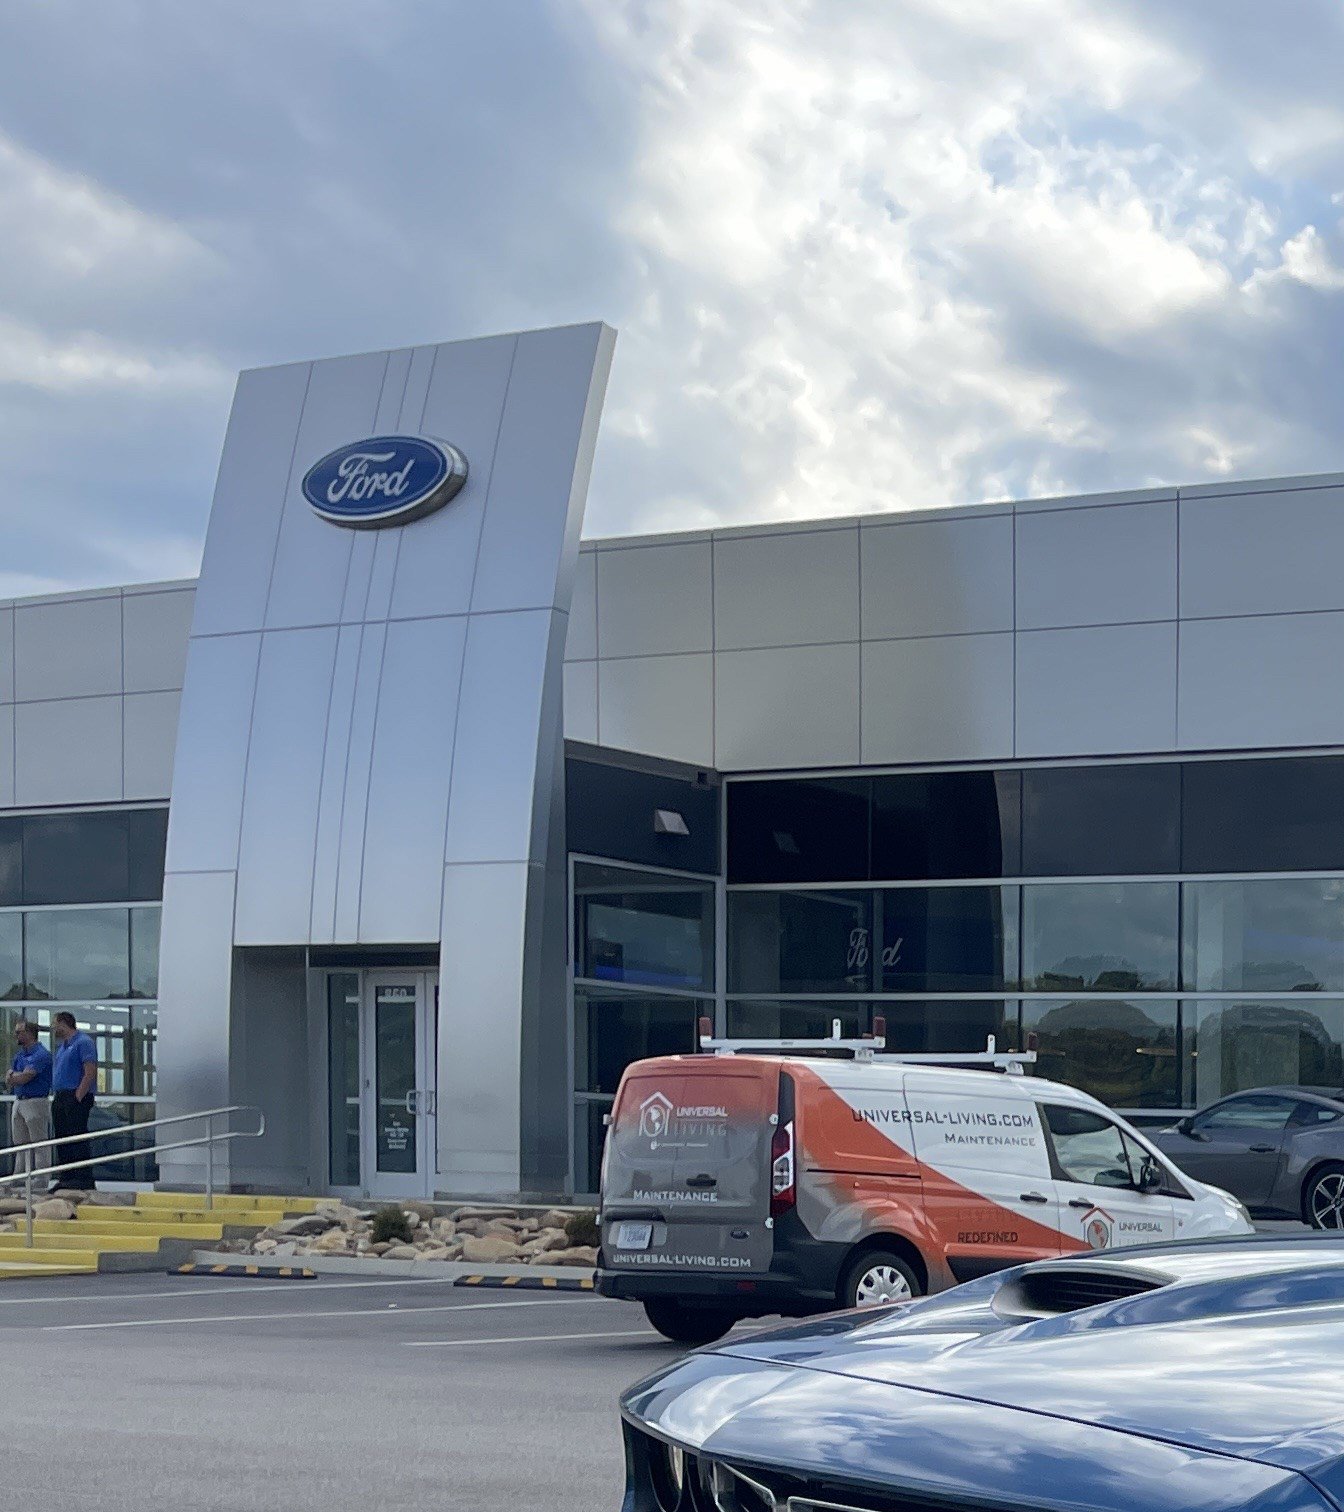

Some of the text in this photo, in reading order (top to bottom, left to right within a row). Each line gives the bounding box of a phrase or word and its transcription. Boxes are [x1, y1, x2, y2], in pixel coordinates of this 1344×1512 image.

[327, 450, 416, 504] Ford
[847, 927, 904, 970] Fod
[676, 1106, 728, 1117] UNIVERSAL
[944, 1133, 1036, 1147] MAINTENANCE
[633, 1190, 718, 1202] MAINTENANCE
[1118, 1221, 1163, 1233] UNIVERSAL
[957, 1231, 1018, 1244] REDEFINED
